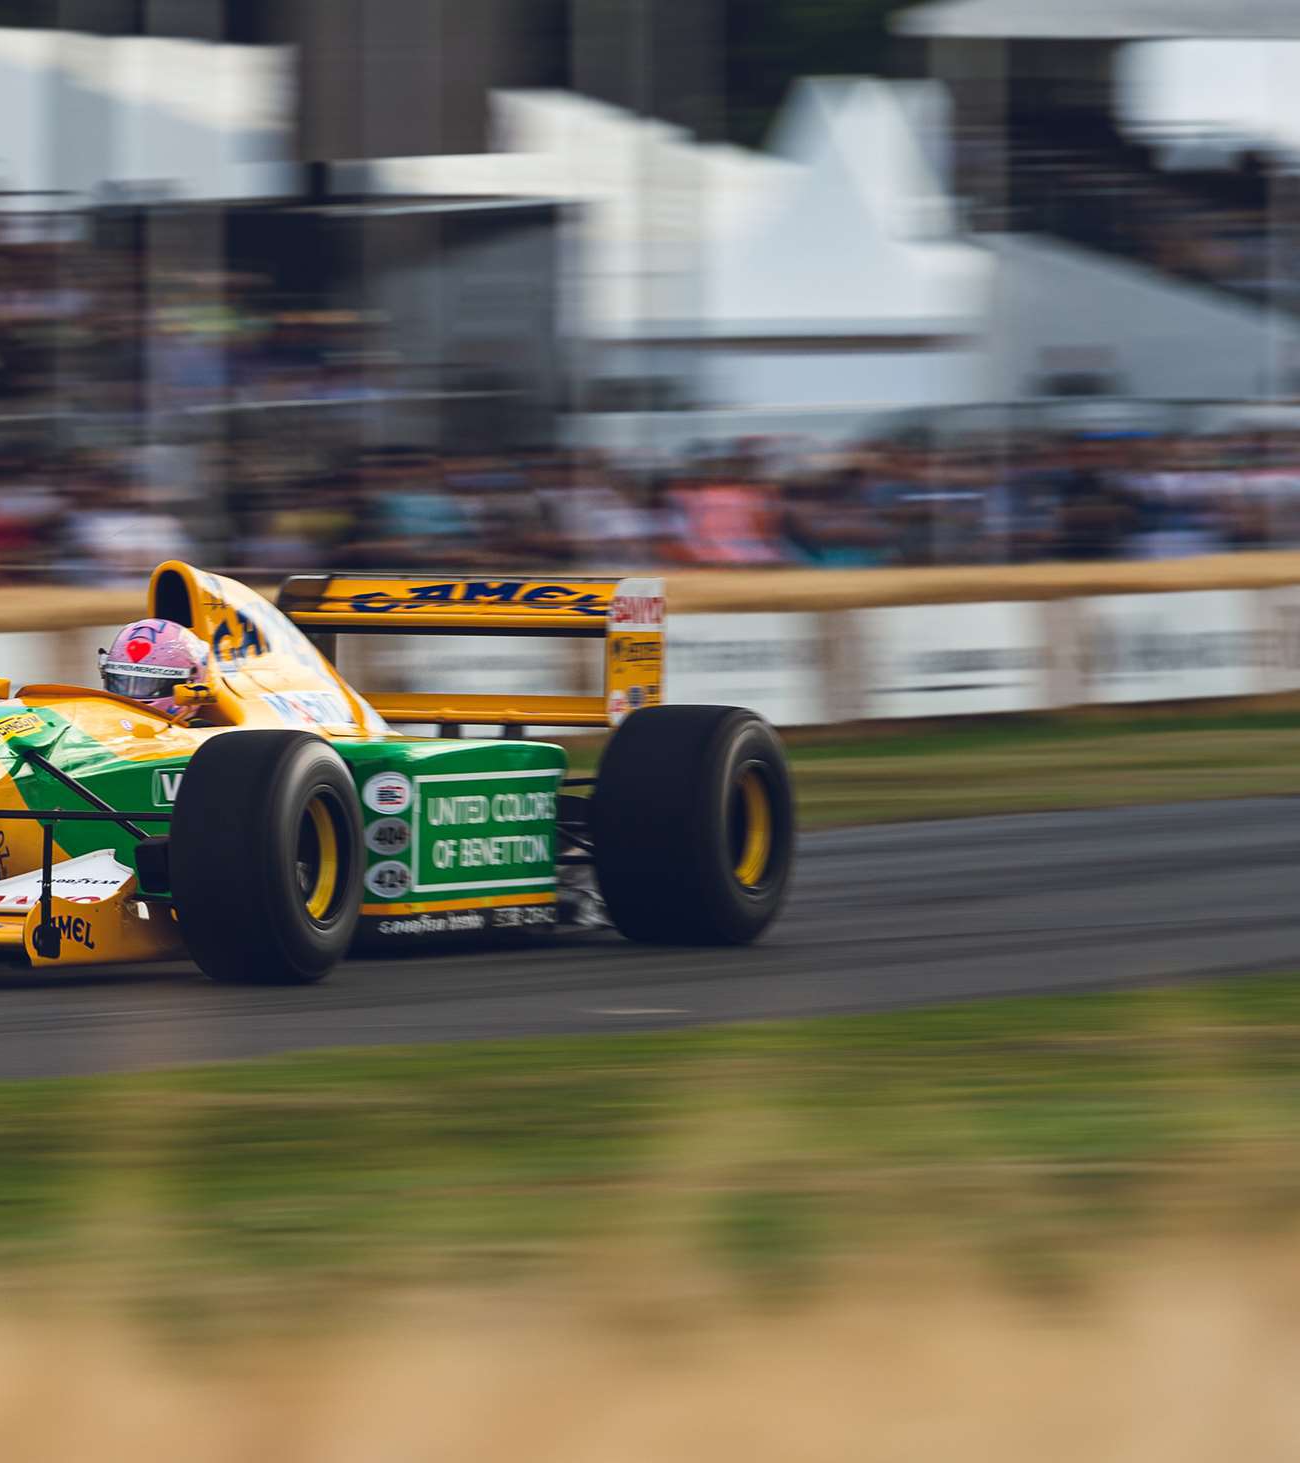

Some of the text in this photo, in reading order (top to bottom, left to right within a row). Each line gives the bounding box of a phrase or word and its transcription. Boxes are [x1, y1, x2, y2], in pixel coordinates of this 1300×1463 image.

[348, 582, 613, 616] CAMEL
[427, 795, 490, 826] UNITED
[491, 792, 557, 822] COLORS
[432, 834, 550, 869] OF BENETTON
